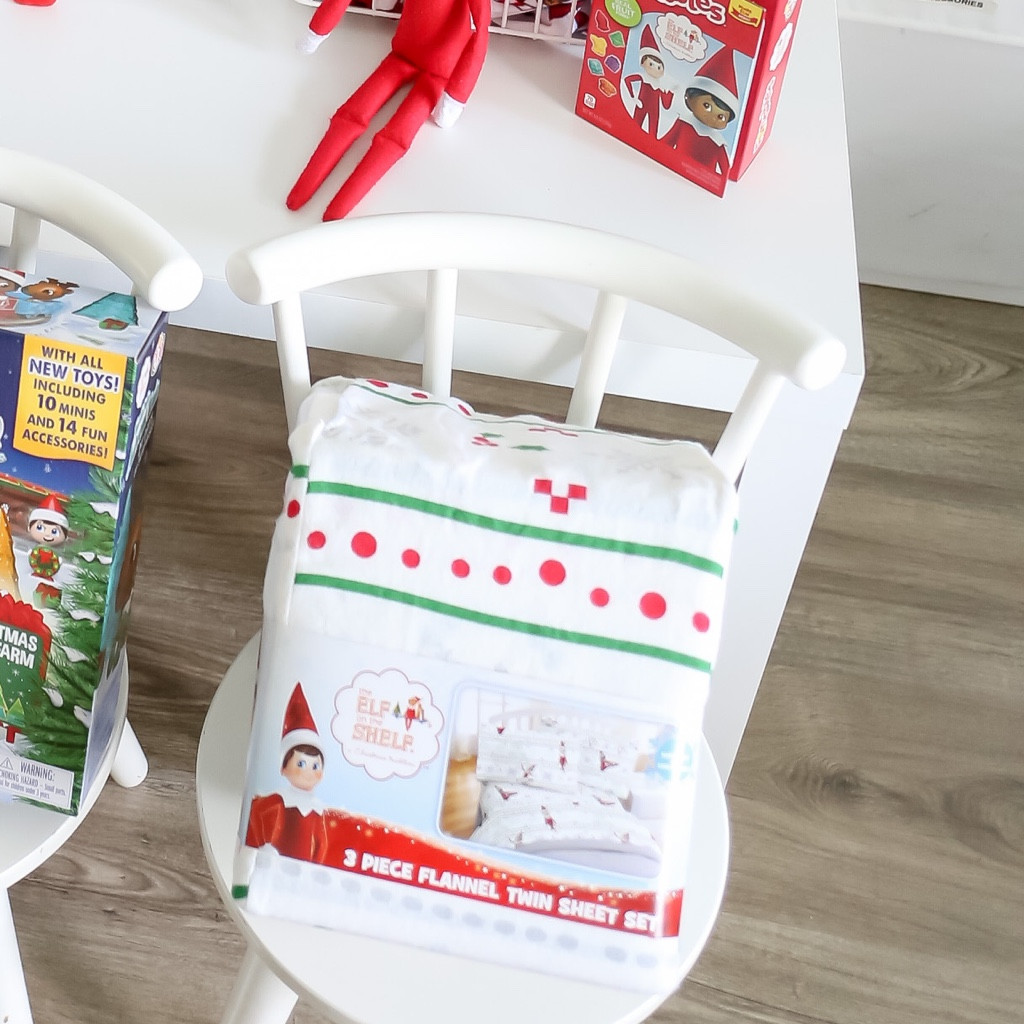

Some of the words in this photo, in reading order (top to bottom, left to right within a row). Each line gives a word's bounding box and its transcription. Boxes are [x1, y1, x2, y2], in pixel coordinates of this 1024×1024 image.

[41, 345, 76, 364] WITH
[81, 354, 104, 370] ALL
[29, 358, 68, 379] NEW
[72, 368, 119, 391] TOYS!
[33, 378, 106, 404] INCLUDING
[37, 394, 57, 412] 10
[59, 403, 96, 421] MINIS
[27, 413, 55, 429] AND
[58, 417, 77, 434] 14
[82, 426, 108, 442] FUN
[22, 428, 108, 459] ACCESSORIES!
[358, 696, 391, 717] ELF
[21, 761, 55, 781] WARNING:
[21, 776, 38, 787] HAZARD
[343, 848, 357, 869] 3
[361, 853, 413, 881] PIECE
[417, 866, 500, 901] FLANNEL
[505, 885, 553, 913] TWIN
[558, 896, 619, 926] SHEET
[623, 911, 657, 933] SET
